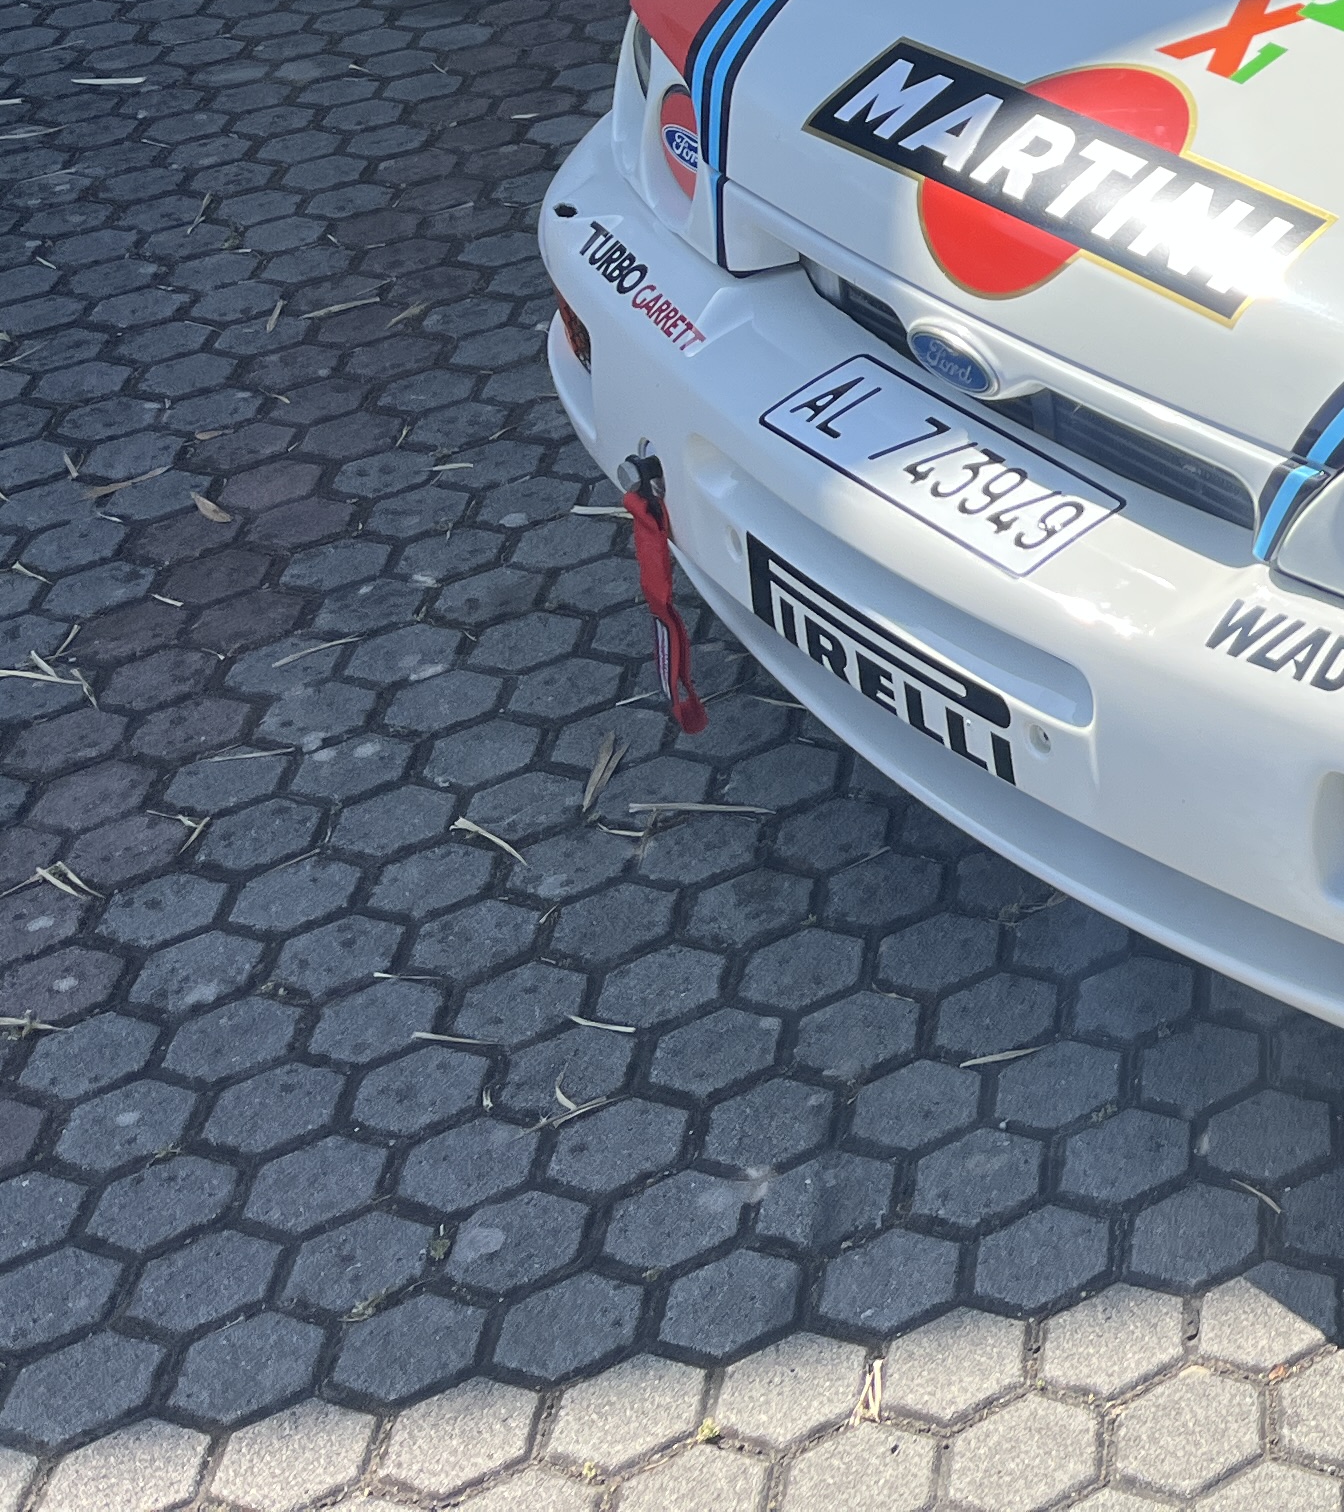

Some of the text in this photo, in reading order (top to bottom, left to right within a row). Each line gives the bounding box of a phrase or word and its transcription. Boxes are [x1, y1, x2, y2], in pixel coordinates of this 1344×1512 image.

[672, 131, 699, 164] For
[833, 58, 1295, 294] MARTINI
[578, 221, 648, 295] TURBO
[632, 284, 706, 353] GARRETT
[927, 340, 972, 384] Ford
[789, 376, 1085, 549] AL 743949
[746, 530, 1017, 787] PIRELLI
